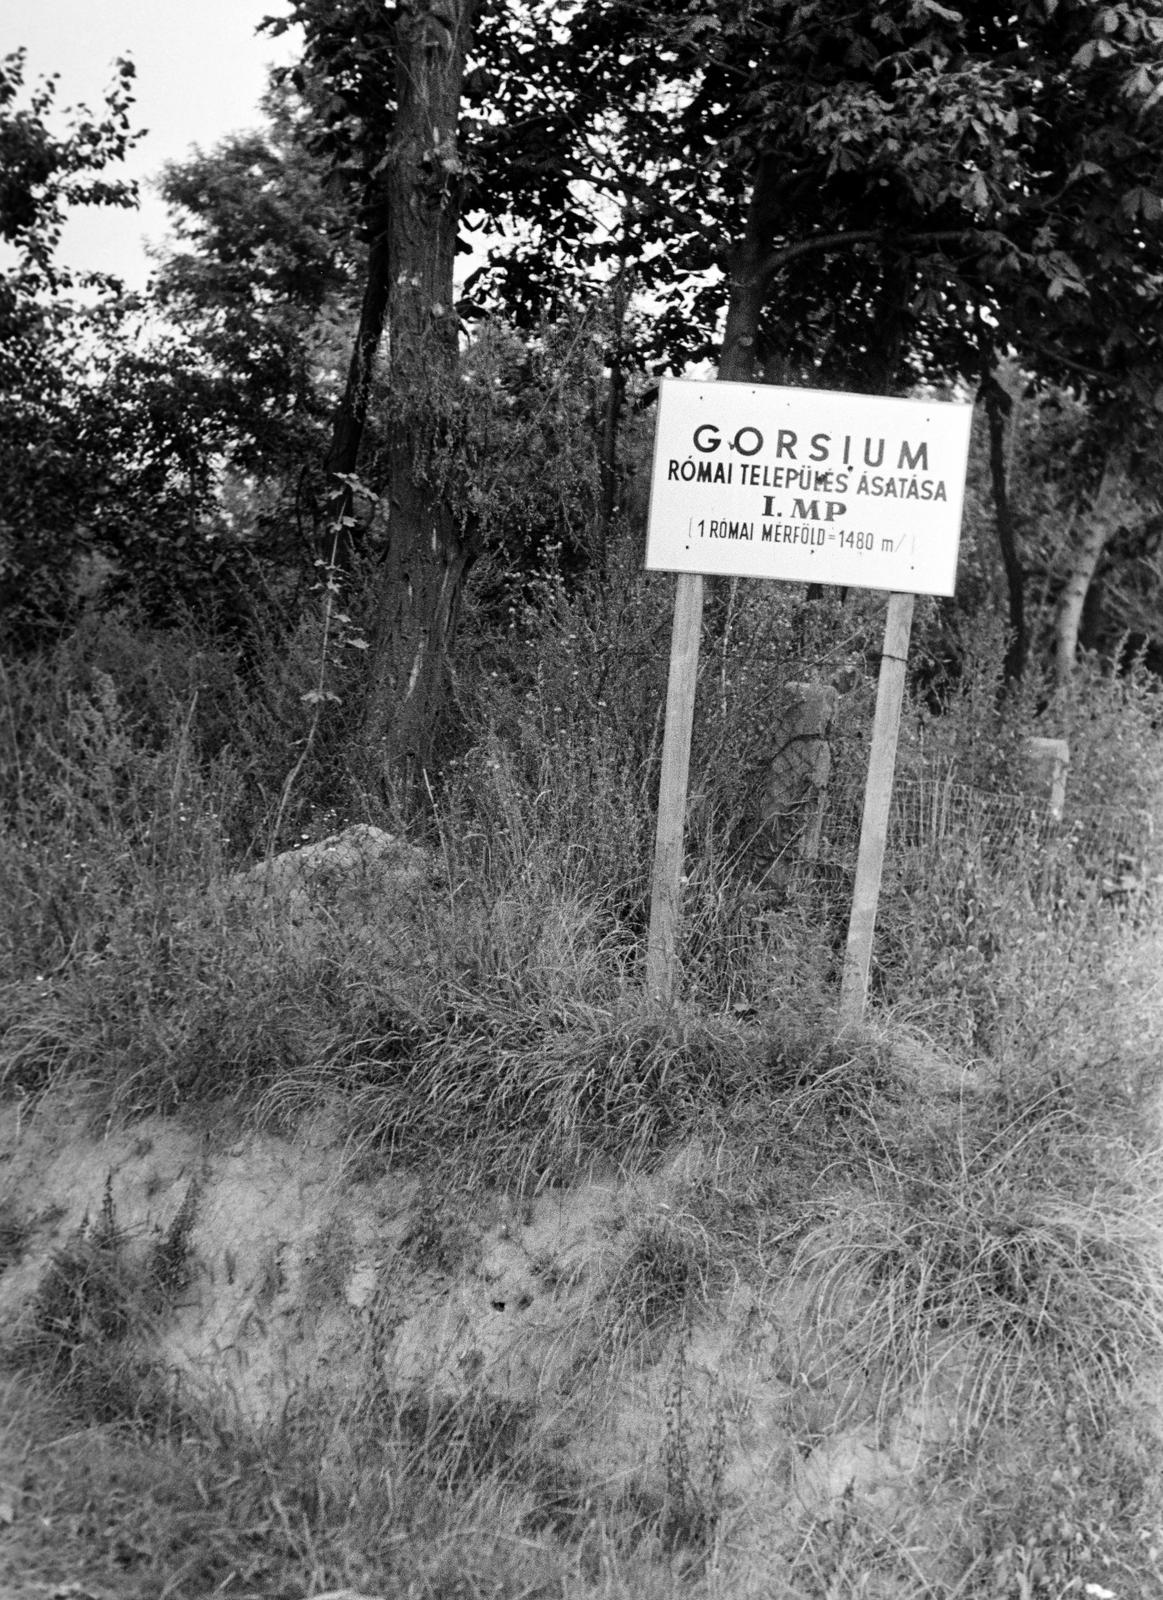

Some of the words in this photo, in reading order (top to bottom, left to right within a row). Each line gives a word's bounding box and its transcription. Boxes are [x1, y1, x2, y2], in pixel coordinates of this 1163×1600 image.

[692, 423, 929, 471] GORSIUM
[667, 455, 733, 485] RÓMAI
[740, 464, 849, 494] TELEPÜLÉS
[856, 471, 948, 502] ÁSATÁSA
[709, 517, 755, 541] RÓMAI
